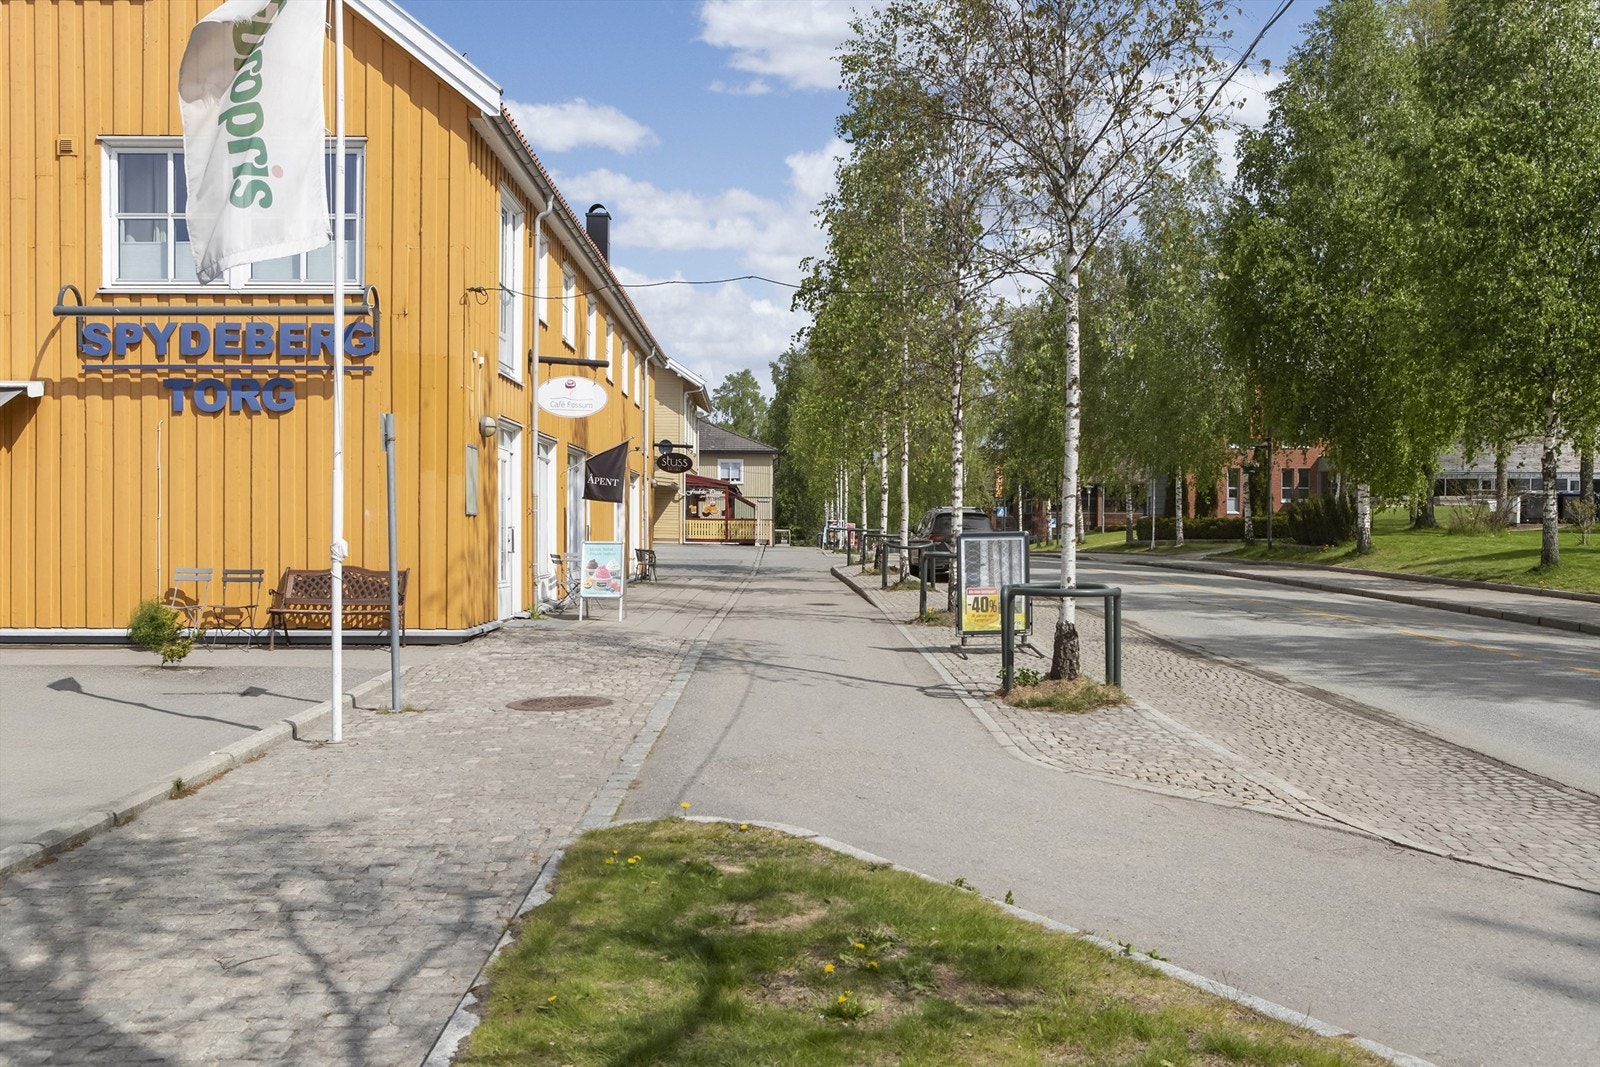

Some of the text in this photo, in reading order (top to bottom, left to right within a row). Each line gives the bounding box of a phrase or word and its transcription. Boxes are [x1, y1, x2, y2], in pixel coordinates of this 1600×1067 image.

[82, 322, 376, 357] SPYDEBERG
[163, 377, 296, 413] TORG
[550, 400, 593, 409] Café Fossum
[587, 473, 620, 487] ÅPENT
